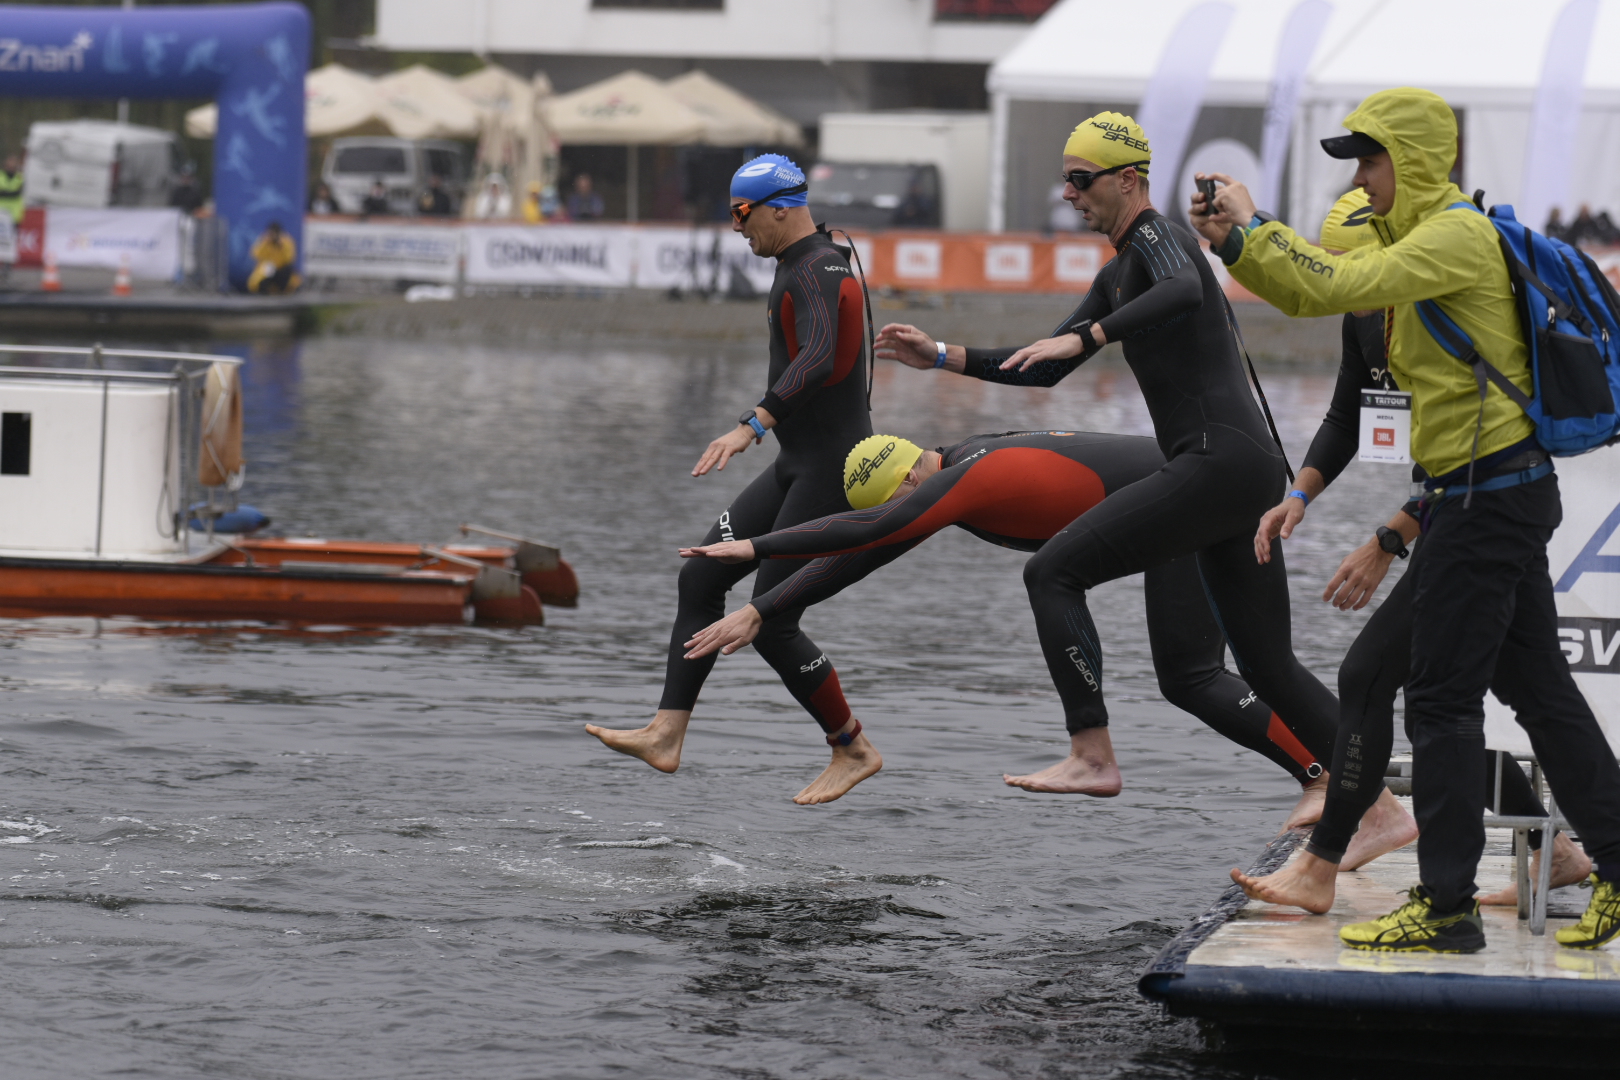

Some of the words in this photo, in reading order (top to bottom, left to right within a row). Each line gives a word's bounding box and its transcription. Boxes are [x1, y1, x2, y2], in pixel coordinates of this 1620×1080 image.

[1089, 121, 1129, 136] AQUA
[1102, 131, 1149, 152] SPEED
[1268, 231, 1334, 279] saomon
[1374, 396, 1407, 406] TRITOUR
[1377, 432, 1391, 442] JBL
[845, 457, 871, 495] AQUA
[859, 441, 896, 486] SPEED
[1065, 645, 1099, 692] fusion
